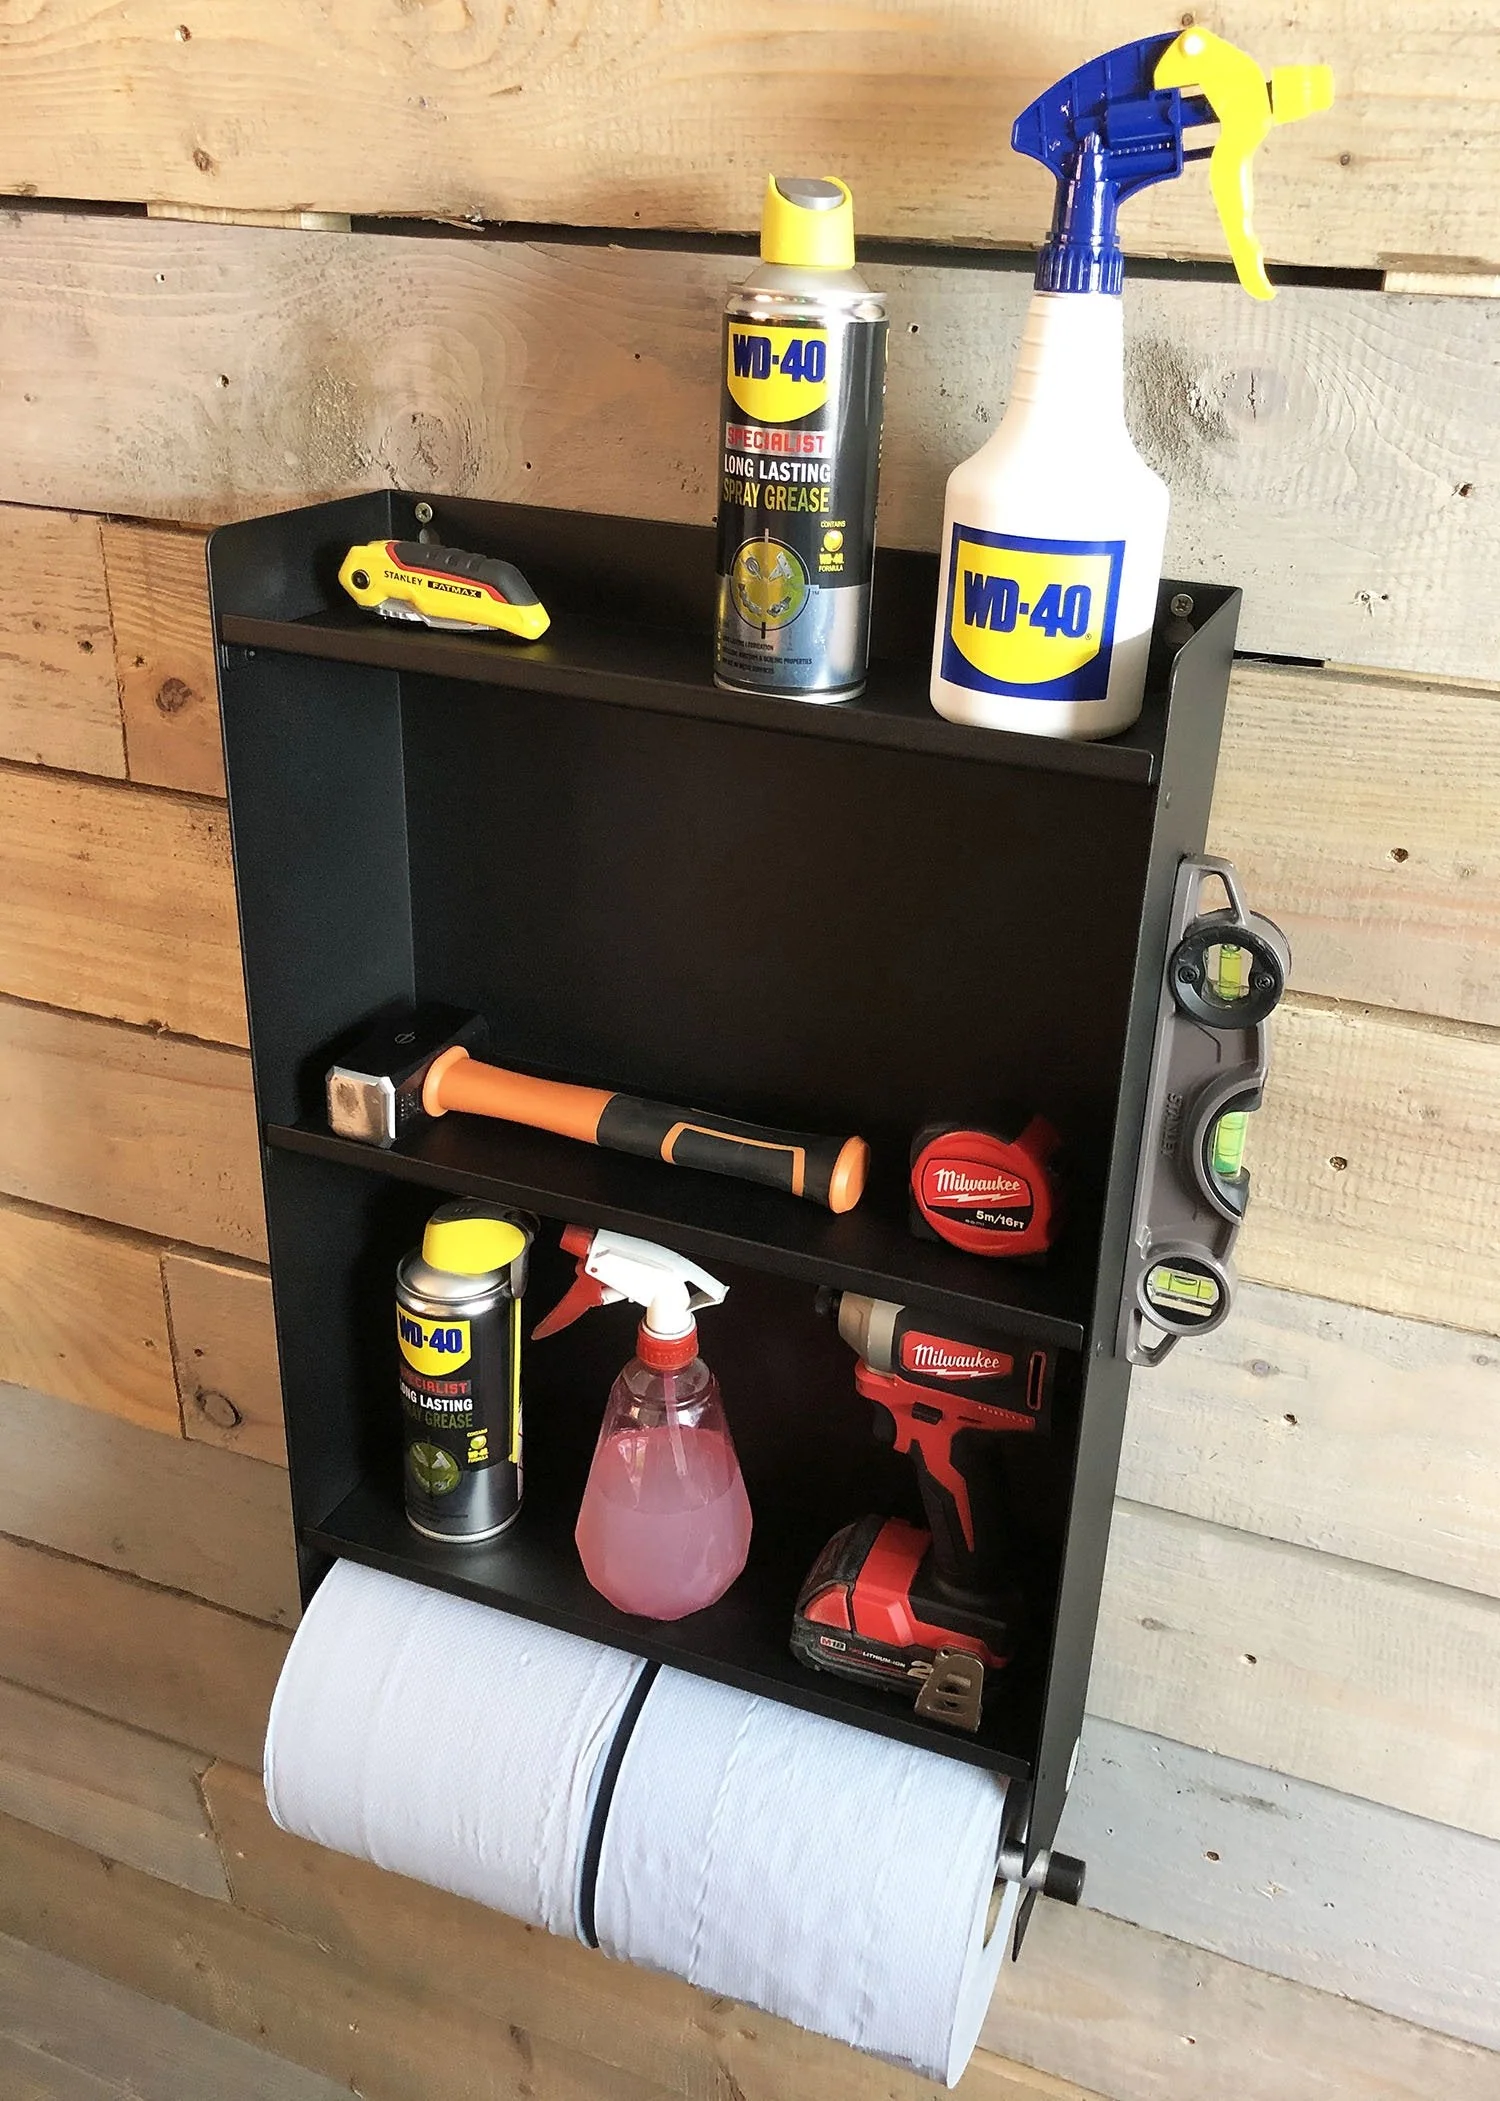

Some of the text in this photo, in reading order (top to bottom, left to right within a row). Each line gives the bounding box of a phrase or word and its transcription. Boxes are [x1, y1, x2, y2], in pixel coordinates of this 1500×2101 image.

[733, 333, 827, 383] WD-40
[727, 426, 825, 453] SPECIALIST
[724, 453, 831, 483] LONG LASTING
[723, 477, 830, 513] SPRAY GREASE
[384, 570, 478, 598] STANLEY FATMAX
[964, 570, 1092, 639] WD-40
[933, 1168, 1021, 1192] Milwaukee
[912, 1344, 1000, 1369] Milwaukee
[420, 1394, 473, 1412] LASTING
[425, 1411, 473, 1428] GREASE
